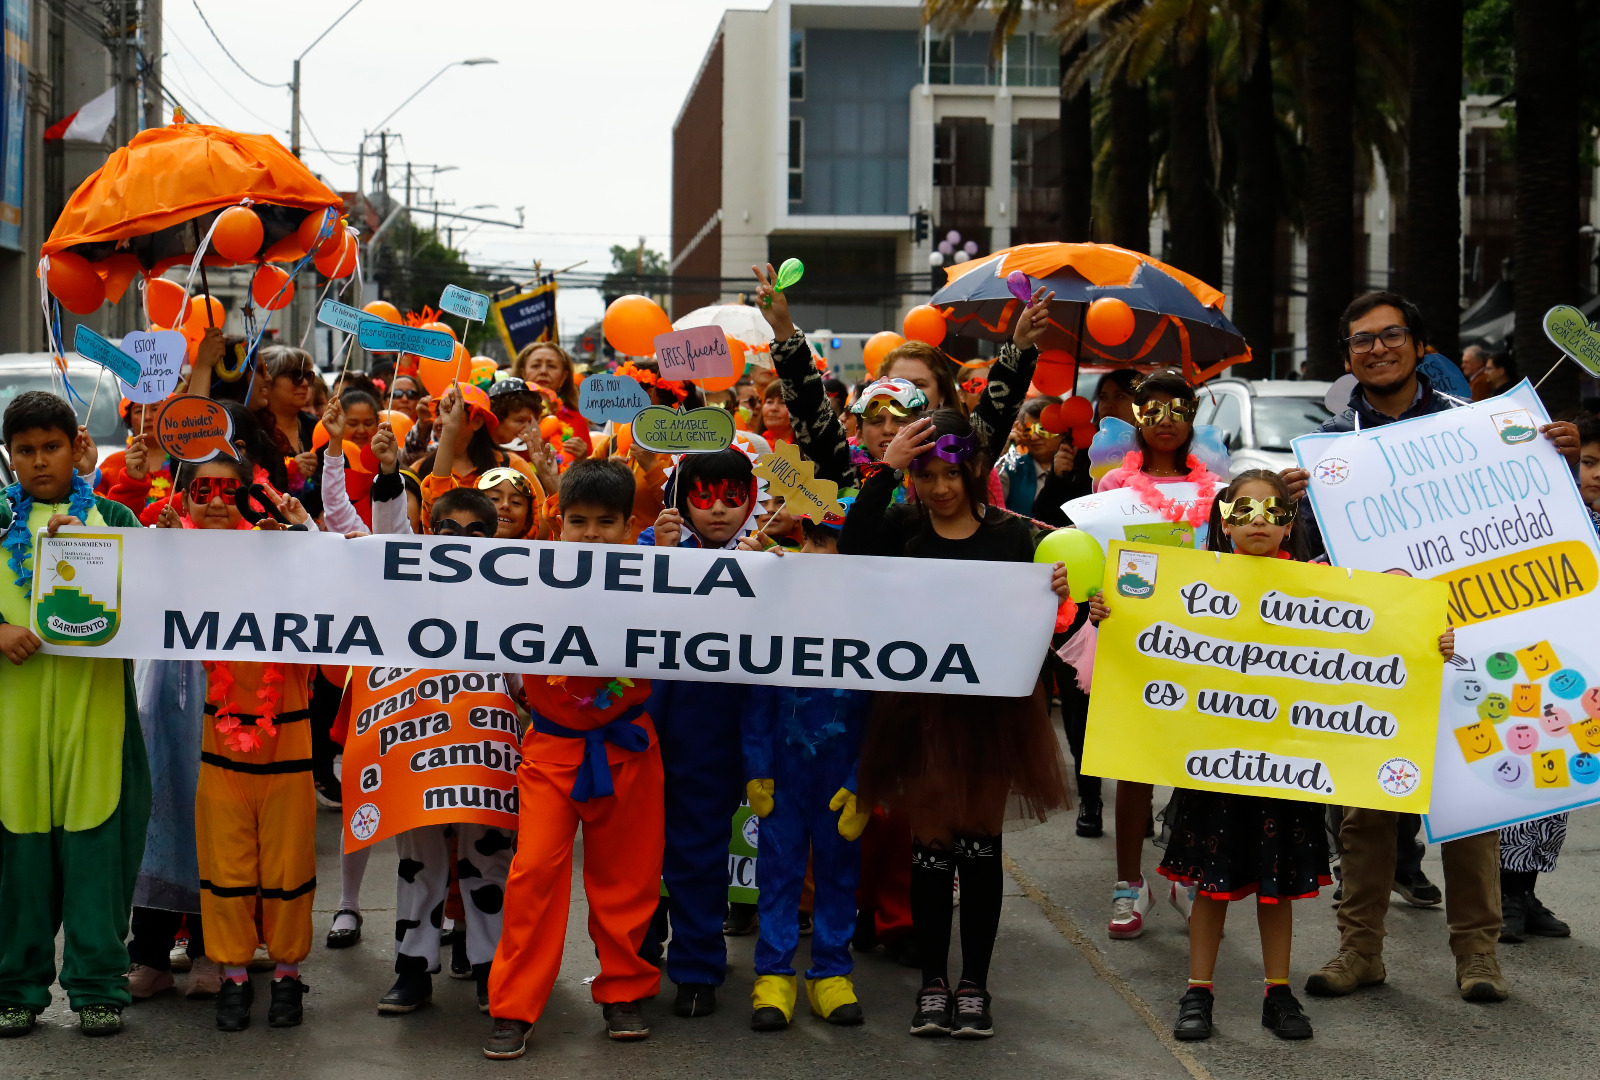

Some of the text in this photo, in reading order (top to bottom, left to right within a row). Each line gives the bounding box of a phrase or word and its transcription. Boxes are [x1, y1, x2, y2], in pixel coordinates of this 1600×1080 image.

[1551, 322, 1569, 340] CON
[1567, 336, 1579, 348] LA
[1563, 318, 1577, 331] SE
[134, 337, 156, 354] ESTOY
[385, 340, 425, 353] COMIENZOS
[397, 332, 407, 341] DE
[407, 333, 421, 344] LOS
[422, 337, 452, 348] NUEVOS
[149, 352, 168, 367] MUY
[661, 337, 727, 371] ERES fuerte
[141, 366, 174, 378] ullosa
[142, 379, 165, 393] DE TI
[590, 378, 604, 393] ERES
[585, 392, 643, 415] importante
[164, 414, 213, 430] No olvides
[653, 419, 709, 430] SE AMABLE
[162, 426, 225, 445] ser agradecido
[645, 430, 718, 442] CON LA GENTE
[1369, 427, 1478, 487] JUNTOS
[1120, 503, 1150, 516] LAS
[1345, 455, 1551, 542] CONSTRUYENDO
[1407, 499, 1554, 571] una sociedad
[383, 541, 757, 598] ESCUELA
[1447, 553, 1584, 625] NCLUSIVA
[1179, 582, 1372, 632] La única
[52, 618, 105, 634] SARMIENTO
[164, 609, 981, 684] MARIA OLGA FIGUEROA
[1138, 628, 1407, 687] discapacidad
[356, 671, 509, 736] gran opor
[1144, 682, 1396, 739] es una mala
[379, 711, 452, 757] para
[362, 767, 379, 789] a
[1185, 749, 1333, 794] actitud.
